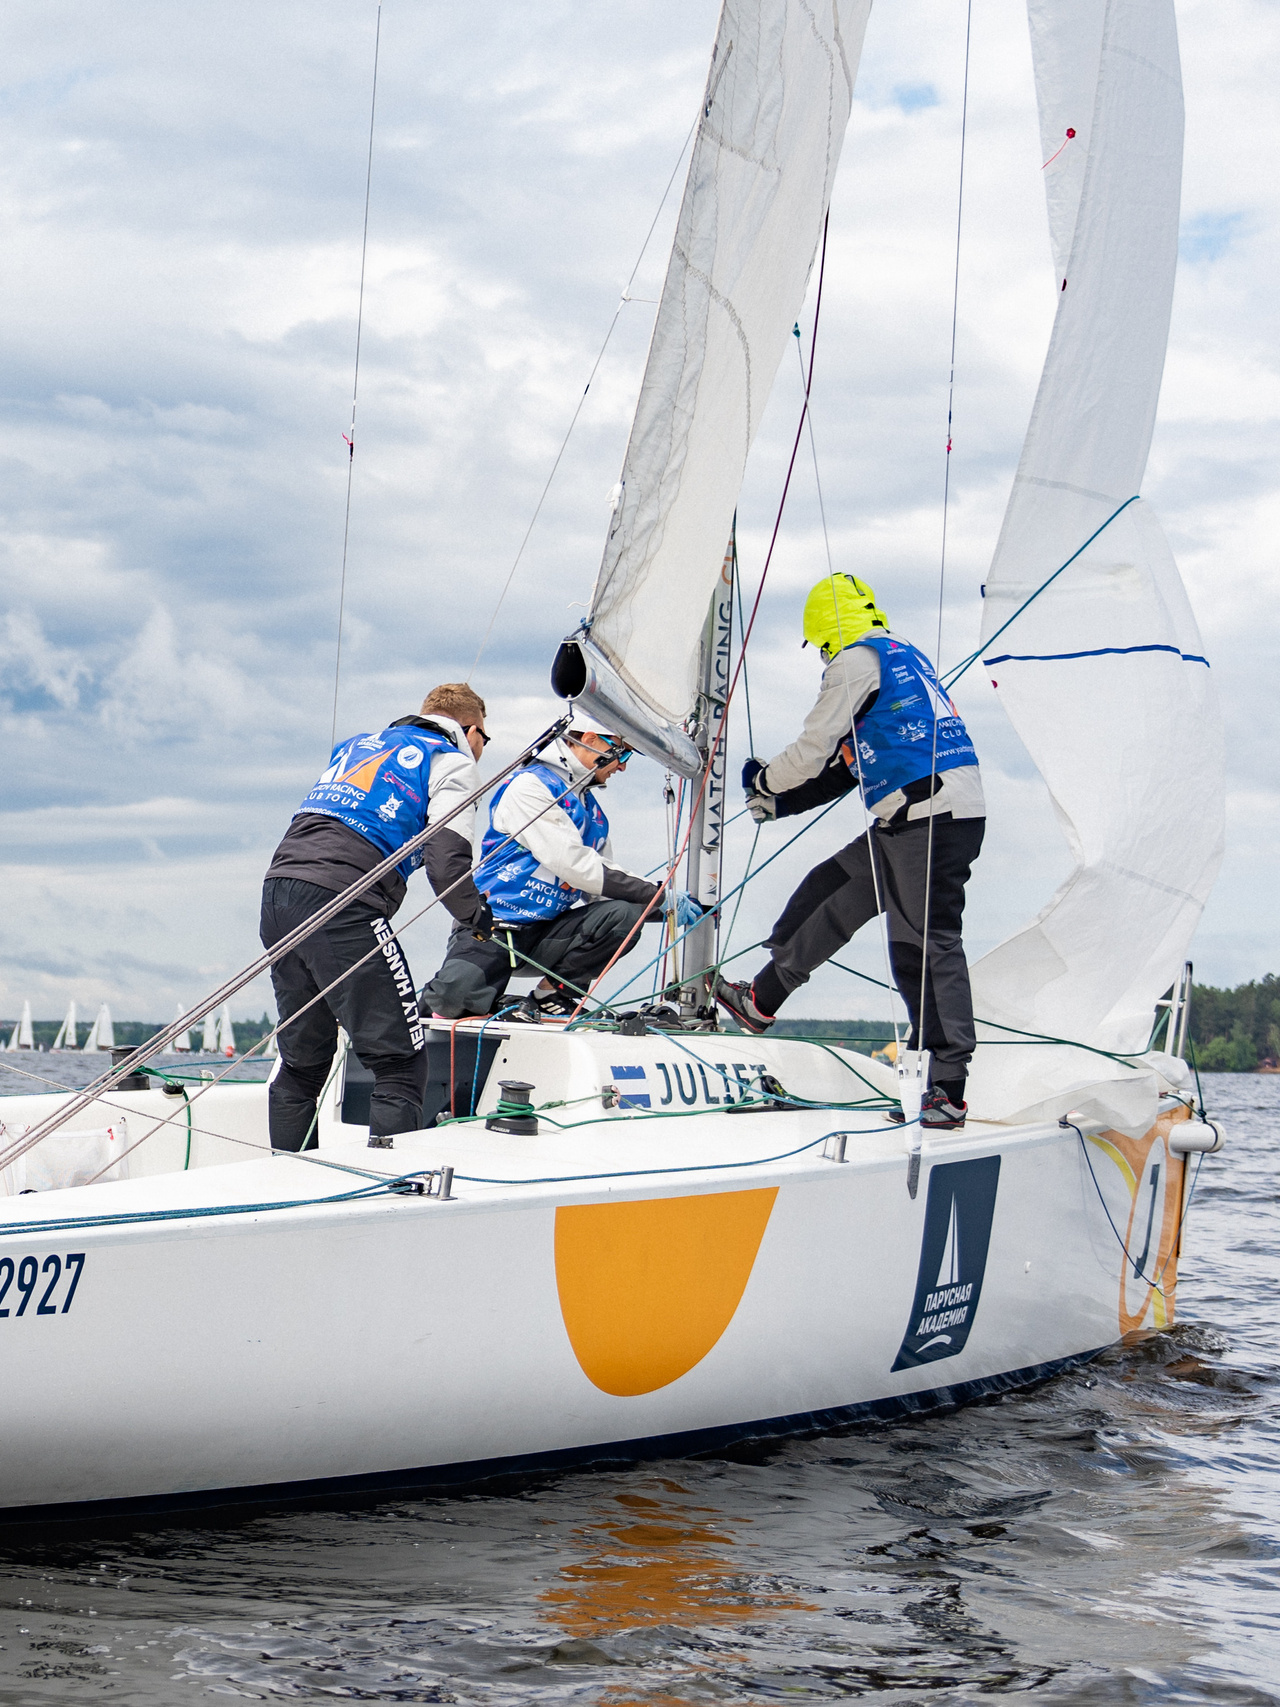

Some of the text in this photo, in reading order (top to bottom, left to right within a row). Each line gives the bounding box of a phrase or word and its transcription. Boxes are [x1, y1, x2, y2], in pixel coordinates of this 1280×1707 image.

[325, 792, 359, 810] TOUR
[330, 783, 367, 801] RACING
[519, 889, 553, 908] CLUB
[524, 879, 559, 898] MATCH
[370, 917, 413, 997] HANSEN
[655, 1062, 771, 1105] JULIET
[923, 1282, 974, 1313] ПАРУСНАЯ
[915, 1305, 969, 1336] АКАДЕМИЯ
